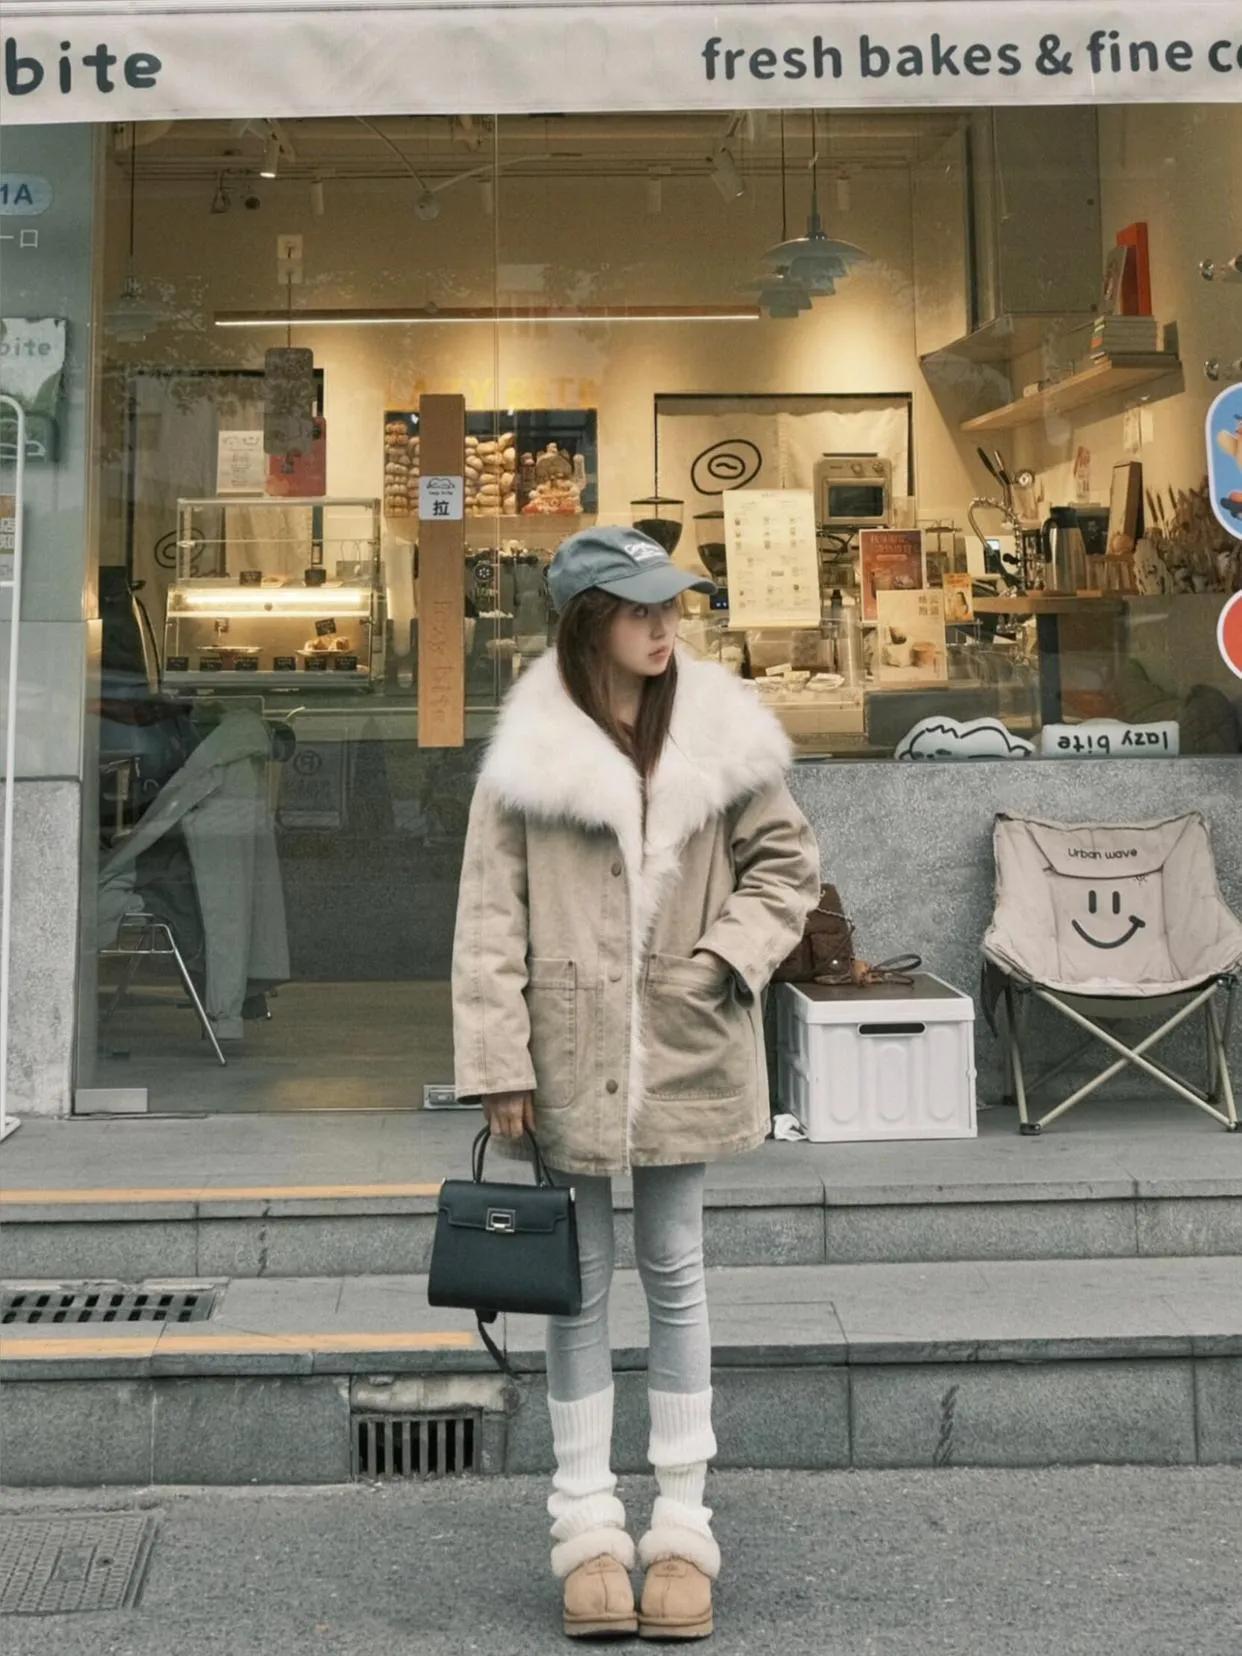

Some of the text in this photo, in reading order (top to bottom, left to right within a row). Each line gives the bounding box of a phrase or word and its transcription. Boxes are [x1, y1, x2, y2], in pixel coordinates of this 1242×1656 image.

[5, 37, 162, 96] bite
[702, 36, 842, 80] fresh
[860, 33, 1021, 77] bakes
[1035, 33, 1073, 75] &
[1087, 30, 1193, 73] fine
[432, 499, 450, 516] 拉
[1057, 730, 1169, 754] lazy bite
[1068, 848, 1138, 860] Urban wave
